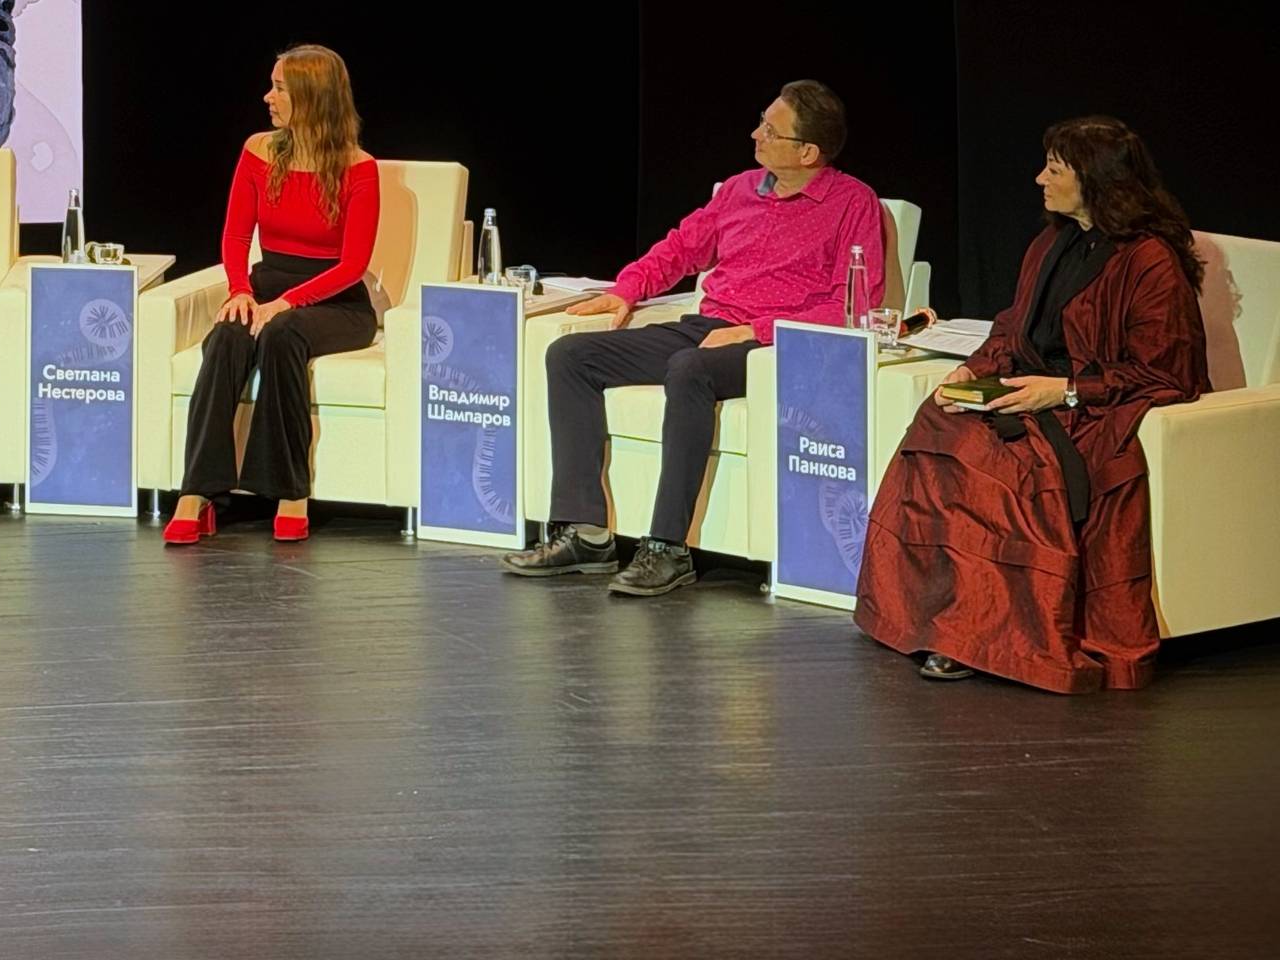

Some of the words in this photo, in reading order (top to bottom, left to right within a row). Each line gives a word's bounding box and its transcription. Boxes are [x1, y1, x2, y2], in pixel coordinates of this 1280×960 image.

[42, 364, 120, 383] Светлана
[38, 383, 125, 404] Нестерова
[428, 384, 510, 410] Владимир
[427, 404, 512, 428] Шампаров
[799, 436, 846, 459] Раиса
[788, 455, 857, 482] Панкова
